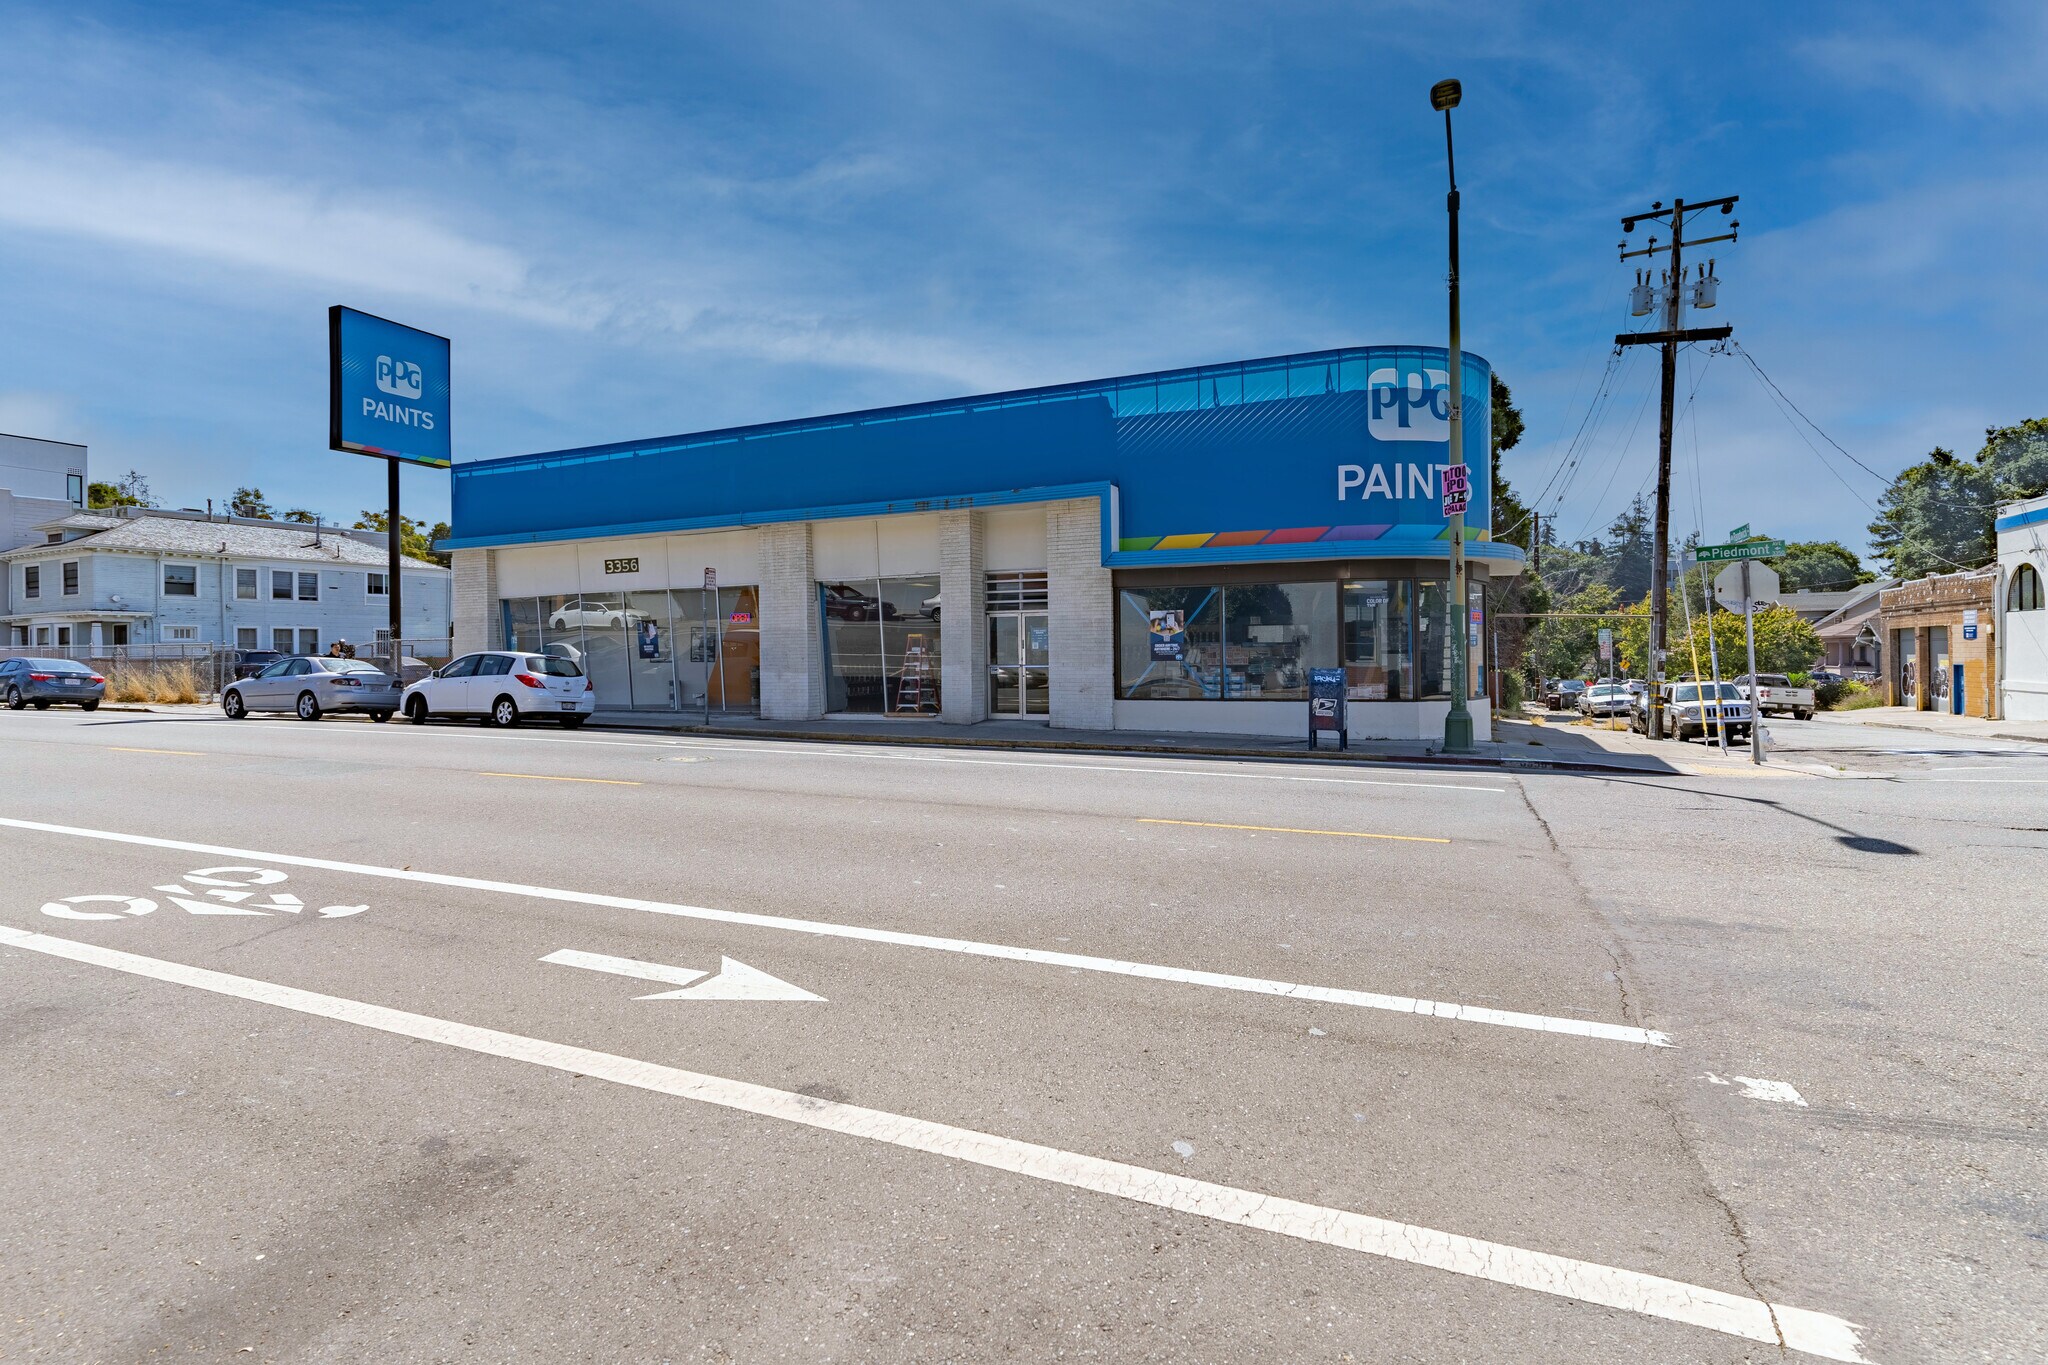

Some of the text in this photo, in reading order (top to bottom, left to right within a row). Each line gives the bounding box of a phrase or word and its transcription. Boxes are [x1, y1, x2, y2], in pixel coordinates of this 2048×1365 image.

[378, 360, 420, 390] PPG
[362, 397, 435, 430] PAINTS
[1712, 545, 1769, 558] Piedmont
[606, 560, 637, 573] 3356
